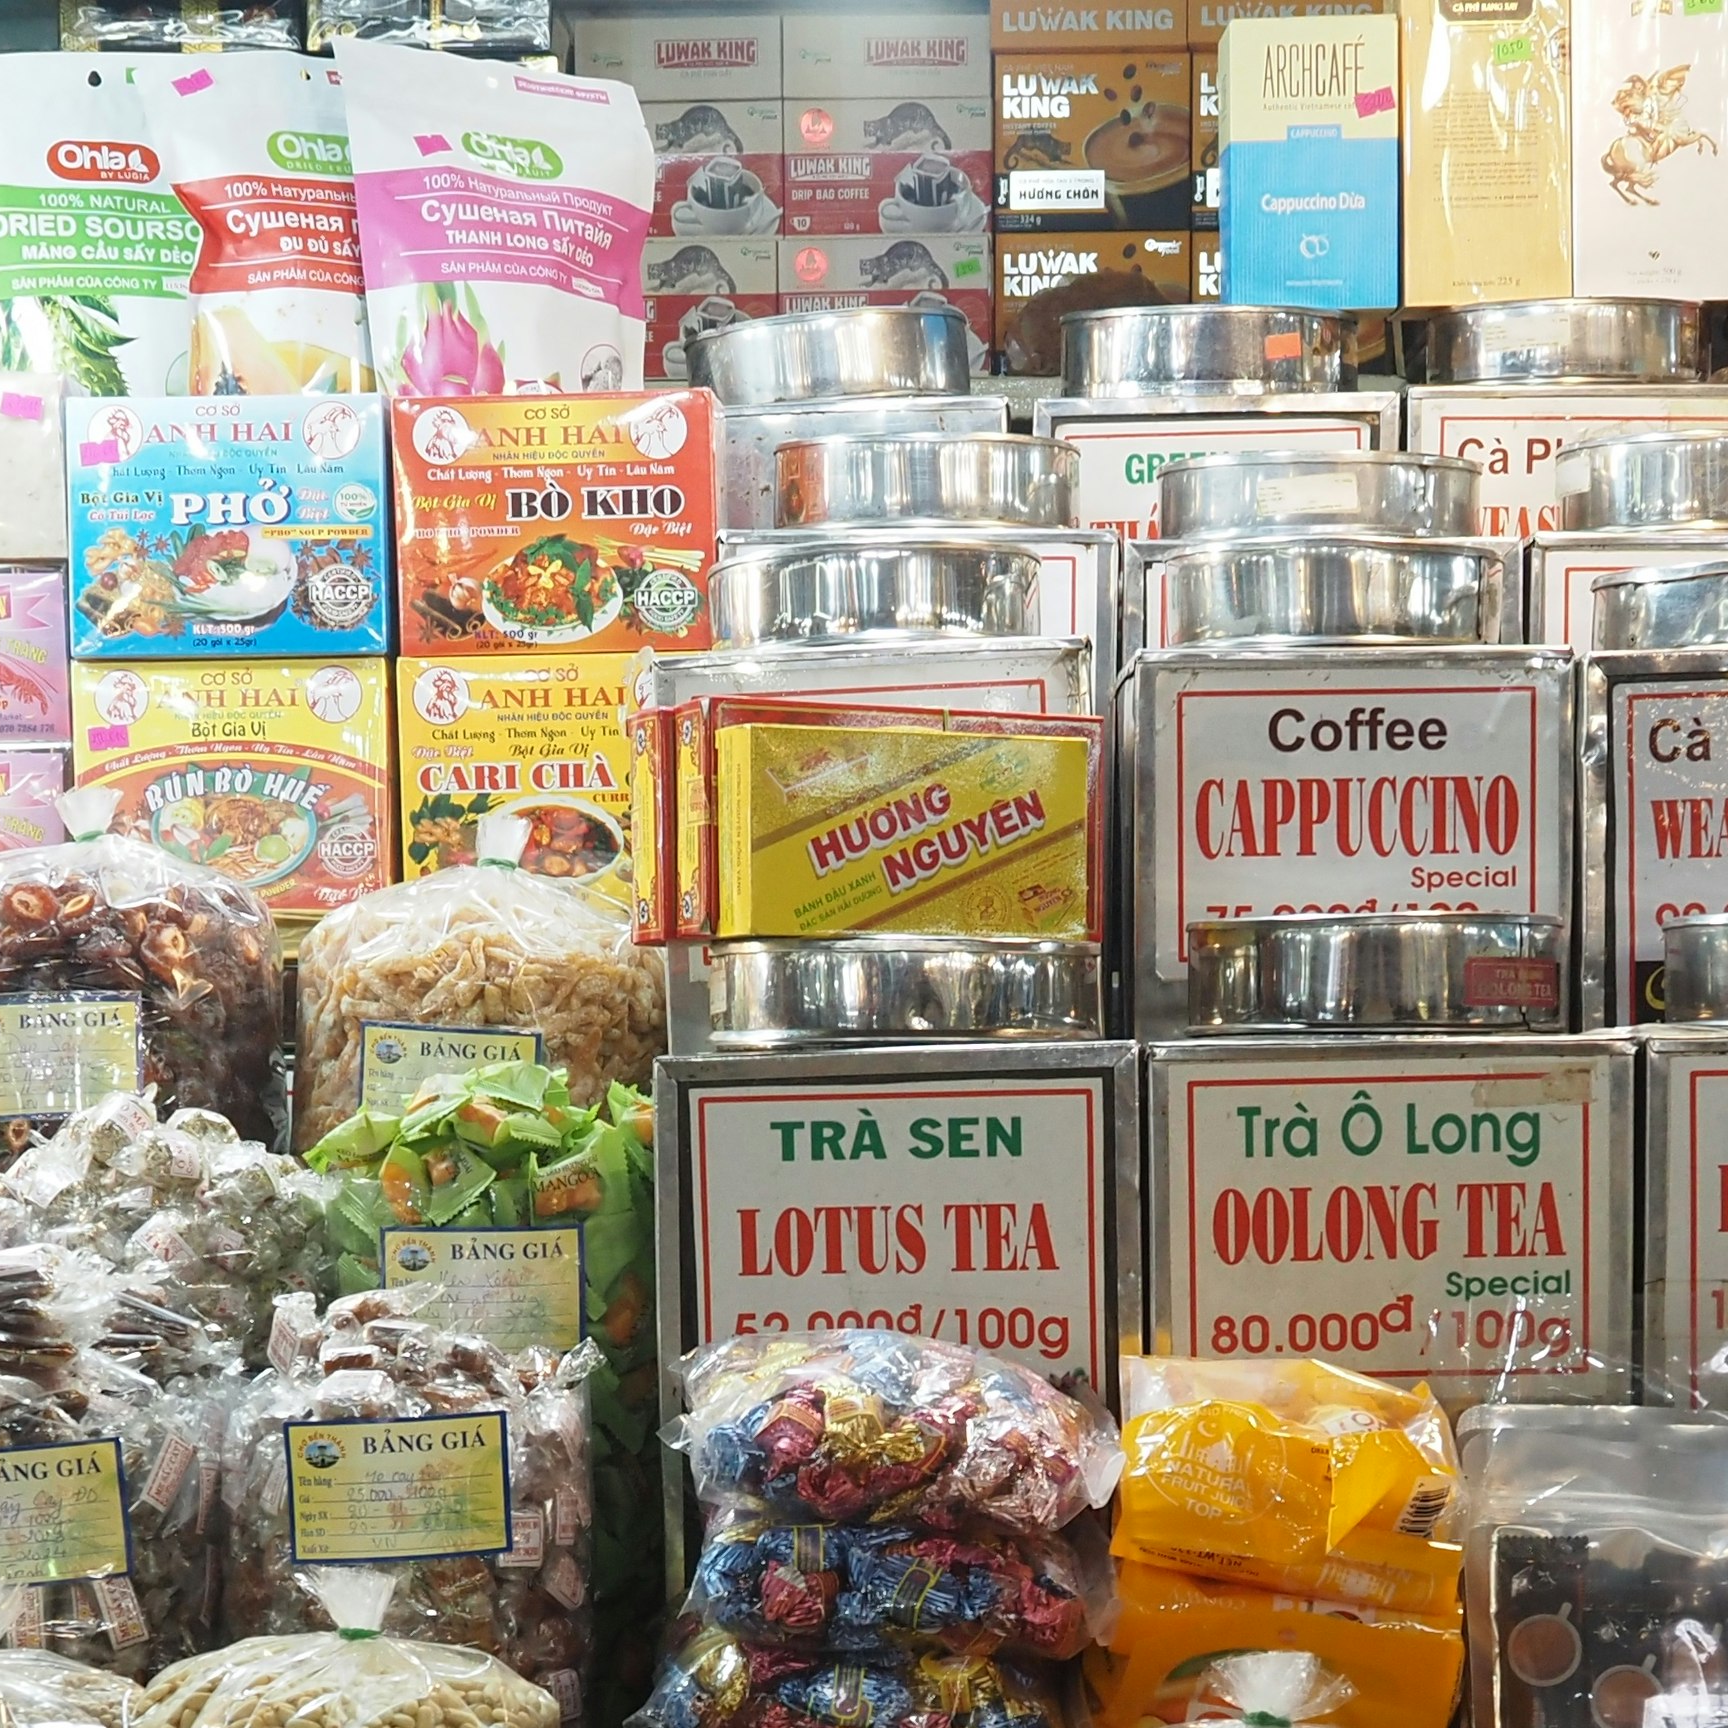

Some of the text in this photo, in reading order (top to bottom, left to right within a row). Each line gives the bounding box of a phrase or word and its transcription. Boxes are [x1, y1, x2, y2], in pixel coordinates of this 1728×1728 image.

[1001, 8, 1174, 31] LUWAK KING
[655, 37, 757, 66] LUWAK KING
[1262, 34, 1365, 101] ARCHCAFÉ
[1002, 74, 1099, 96] LUWAK
[1002, 96, 1071, 119] KING
[56, 146, 126, 171] Ohla
[100, 170, 151, 181] BY LUGIA
[38, 192, 171, 214] 100% NATURAL
[422, 172, 613, 217] 100% Натуральный Продукт
[792, 187, 870, 201] DRIP BAG COFFEE
[1261, 189, 1366, 215] Cappuccino Dừa
[420, 198, 614, 250] Сушеная Питайя
[445, 228, 499, 247] THANH
[505, 231, 548, 252] LONG
[195, 400, 242, 417] CƠ SỞ
[143, 420, 294, 444] ANH HAI
[114, 490, 139, 505] Gia
[169, 478, 291, 526] PHỞ
[507, 478, 685, 523] BÒ KHO
[310, 582, 371, 603] HACCP
[504, 726, 537, 741] Thơm
[539, 727, 567, 743] Ngon
[1268, 706, 1450, 753] Coffee
[1647, 715, 1713, 764] Cà
[146, 771, 207, 812] BÚN
[214, 760, 254, 796] BÒ
[419, 758, 615, 794] CARI CHÀ
[809, 782, 952, 869] HƯƠNG
[1194, 775, 1520, 860] CAPPUCCINO
[882, 789, 1046, 889] NGUYÊN
[1411, 863, 1519, 891] Special
[794, 900, 824, 919] BÁNH
[849, 873, 877, 893] XANH
[769, 1107, 1024, 1162] TRÀ SEN
[1236, 1092, 1543, 1167] Trà Ô Long
[1211, 1179, 1568, 1265] OOLONG TEA
[451, 1236, 563, 1261] BẢNG GIÁ
[736, 1198, 1061, 1278] LOTUS TEA
[1444, 1268, 1572, 1302] Special
[56, 1450, 102, 1476] GIÁ
[1186, 1498, 1222, 1519] TOP
